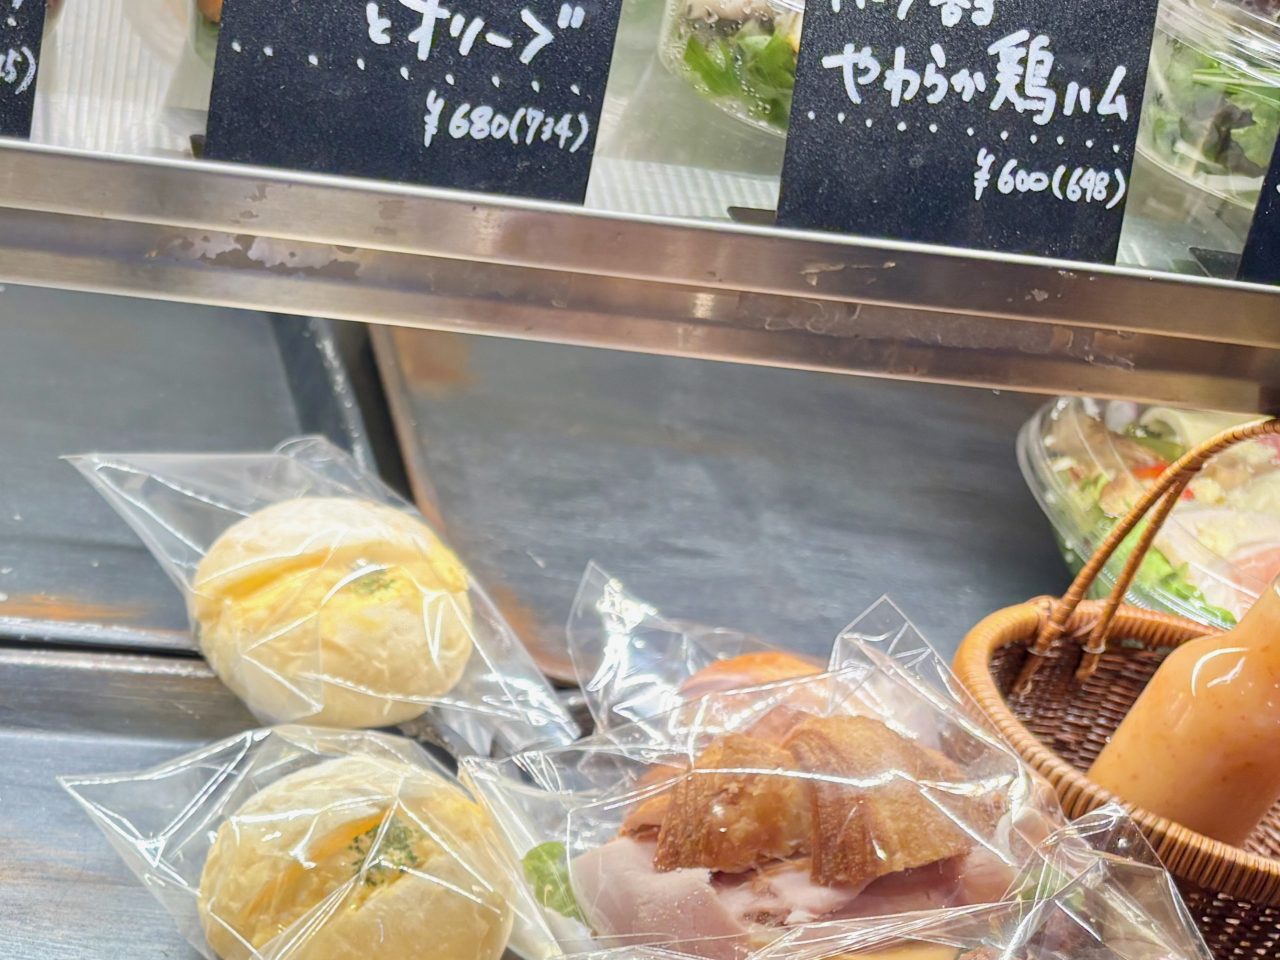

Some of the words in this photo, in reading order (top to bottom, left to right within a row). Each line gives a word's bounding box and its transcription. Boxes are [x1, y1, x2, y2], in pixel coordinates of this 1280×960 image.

[821, 30, 1128, 125] やわらか鶏ハム
[423, 89, 589, 153] ¥680(734)
[973, 148, 1127, 210] ¥600(648)
